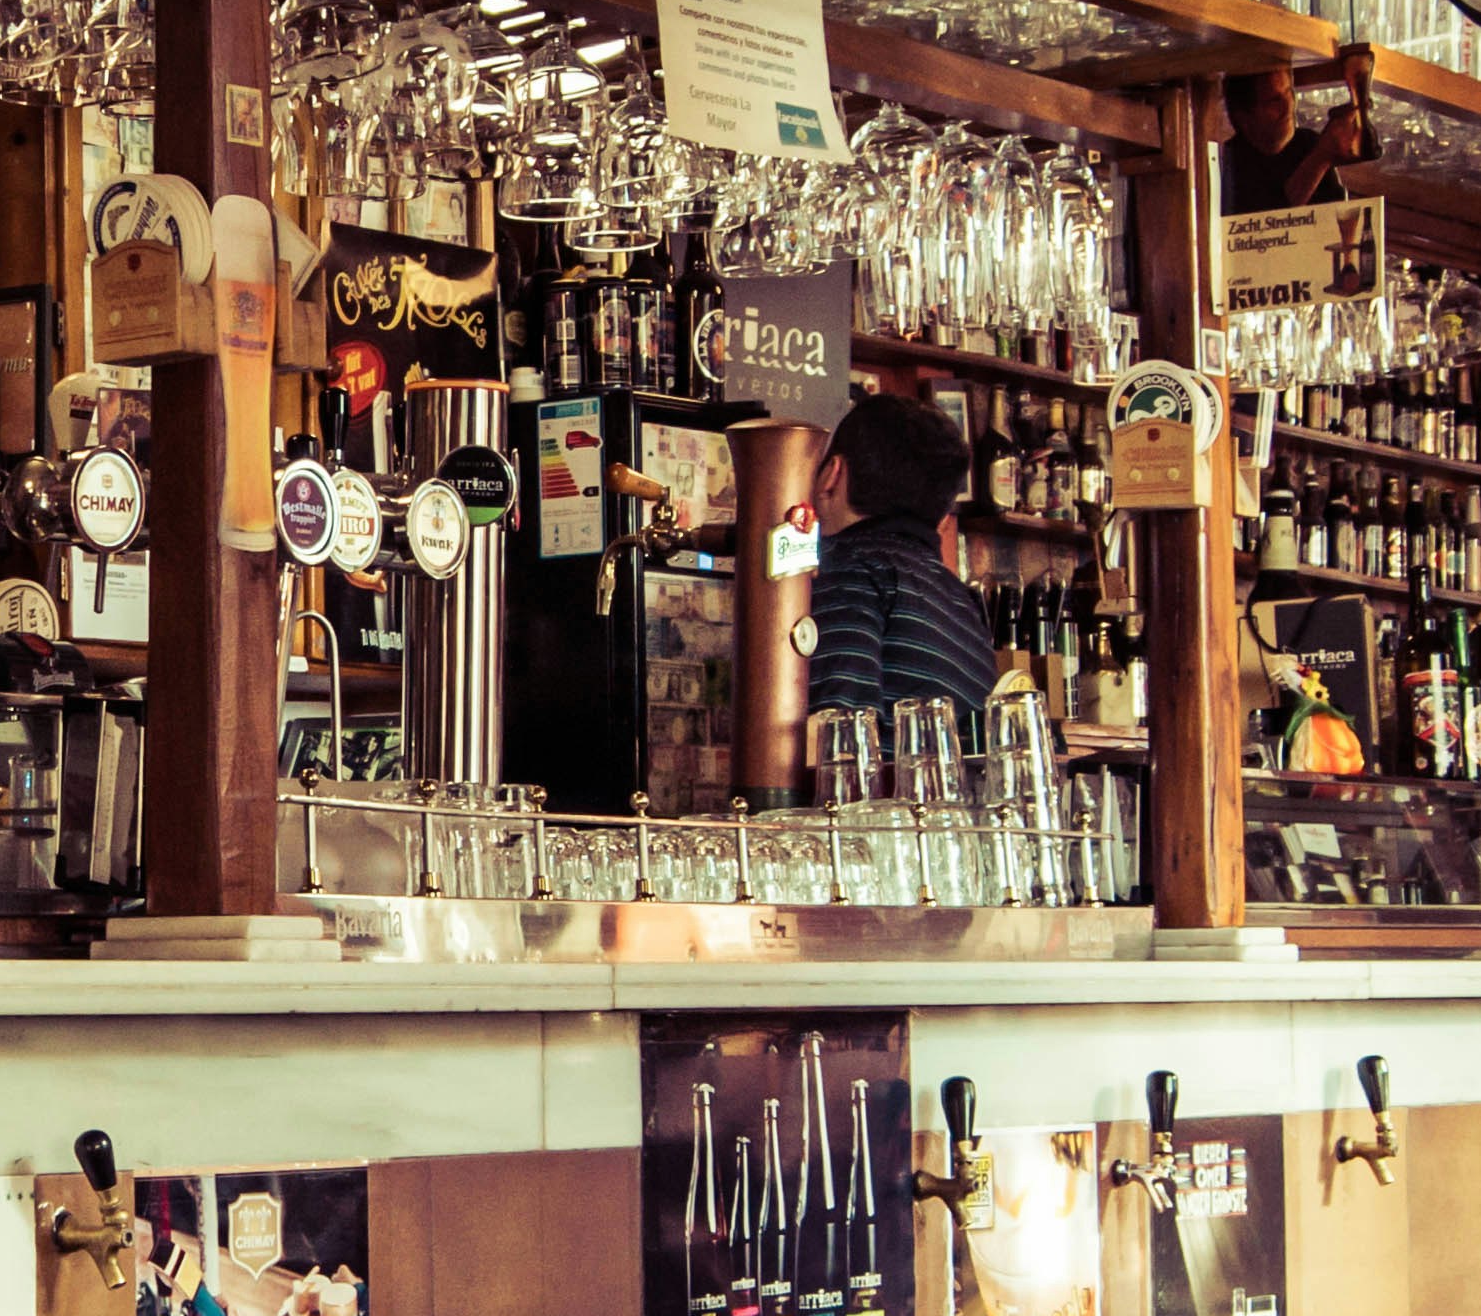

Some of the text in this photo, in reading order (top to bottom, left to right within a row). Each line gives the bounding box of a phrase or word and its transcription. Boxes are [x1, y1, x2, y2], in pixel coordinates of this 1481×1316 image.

[740, 99, 752, 112] La
[706, 112, 737, 132] Mayor
[1134, 373, 1192, 414] BROOKLYN
[79, 493, 135, 514] CHIMAY
